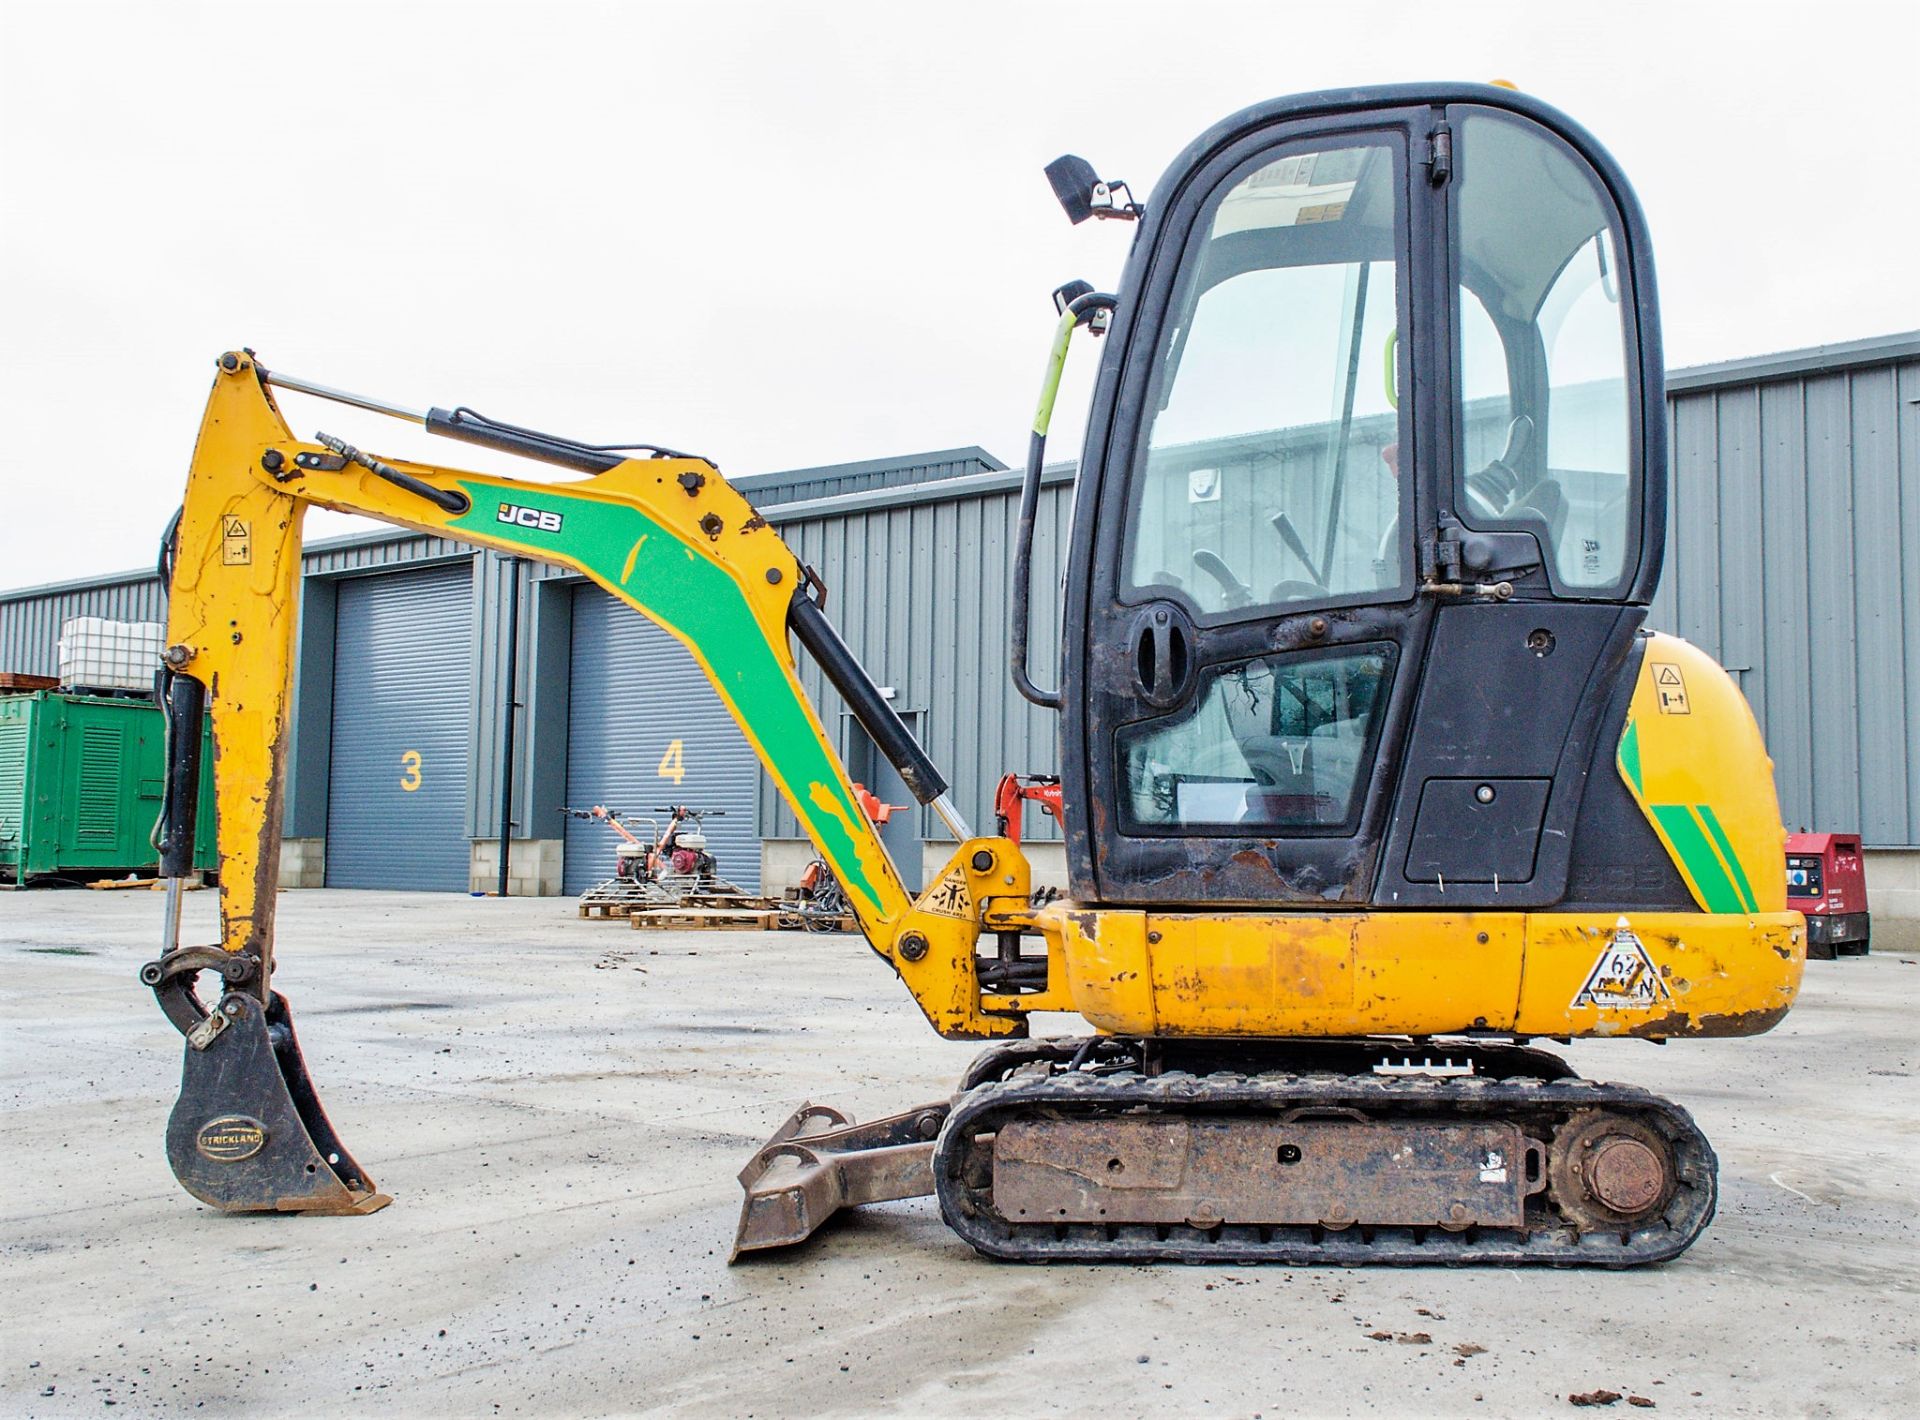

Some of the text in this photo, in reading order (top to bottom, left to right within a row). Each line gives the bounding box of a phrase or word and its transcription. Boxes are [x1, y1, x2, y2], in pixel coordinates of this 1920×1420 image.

[498, 504, 562, 532] JCB
[400, 750, 422, 792] 3
[658, 739, 686, 785] 4
[944, 877, 967, 885] DANGER
[931, 907, 952, 915] CRUSH
[201, 1134, 260, 1145] STRICKLAND
